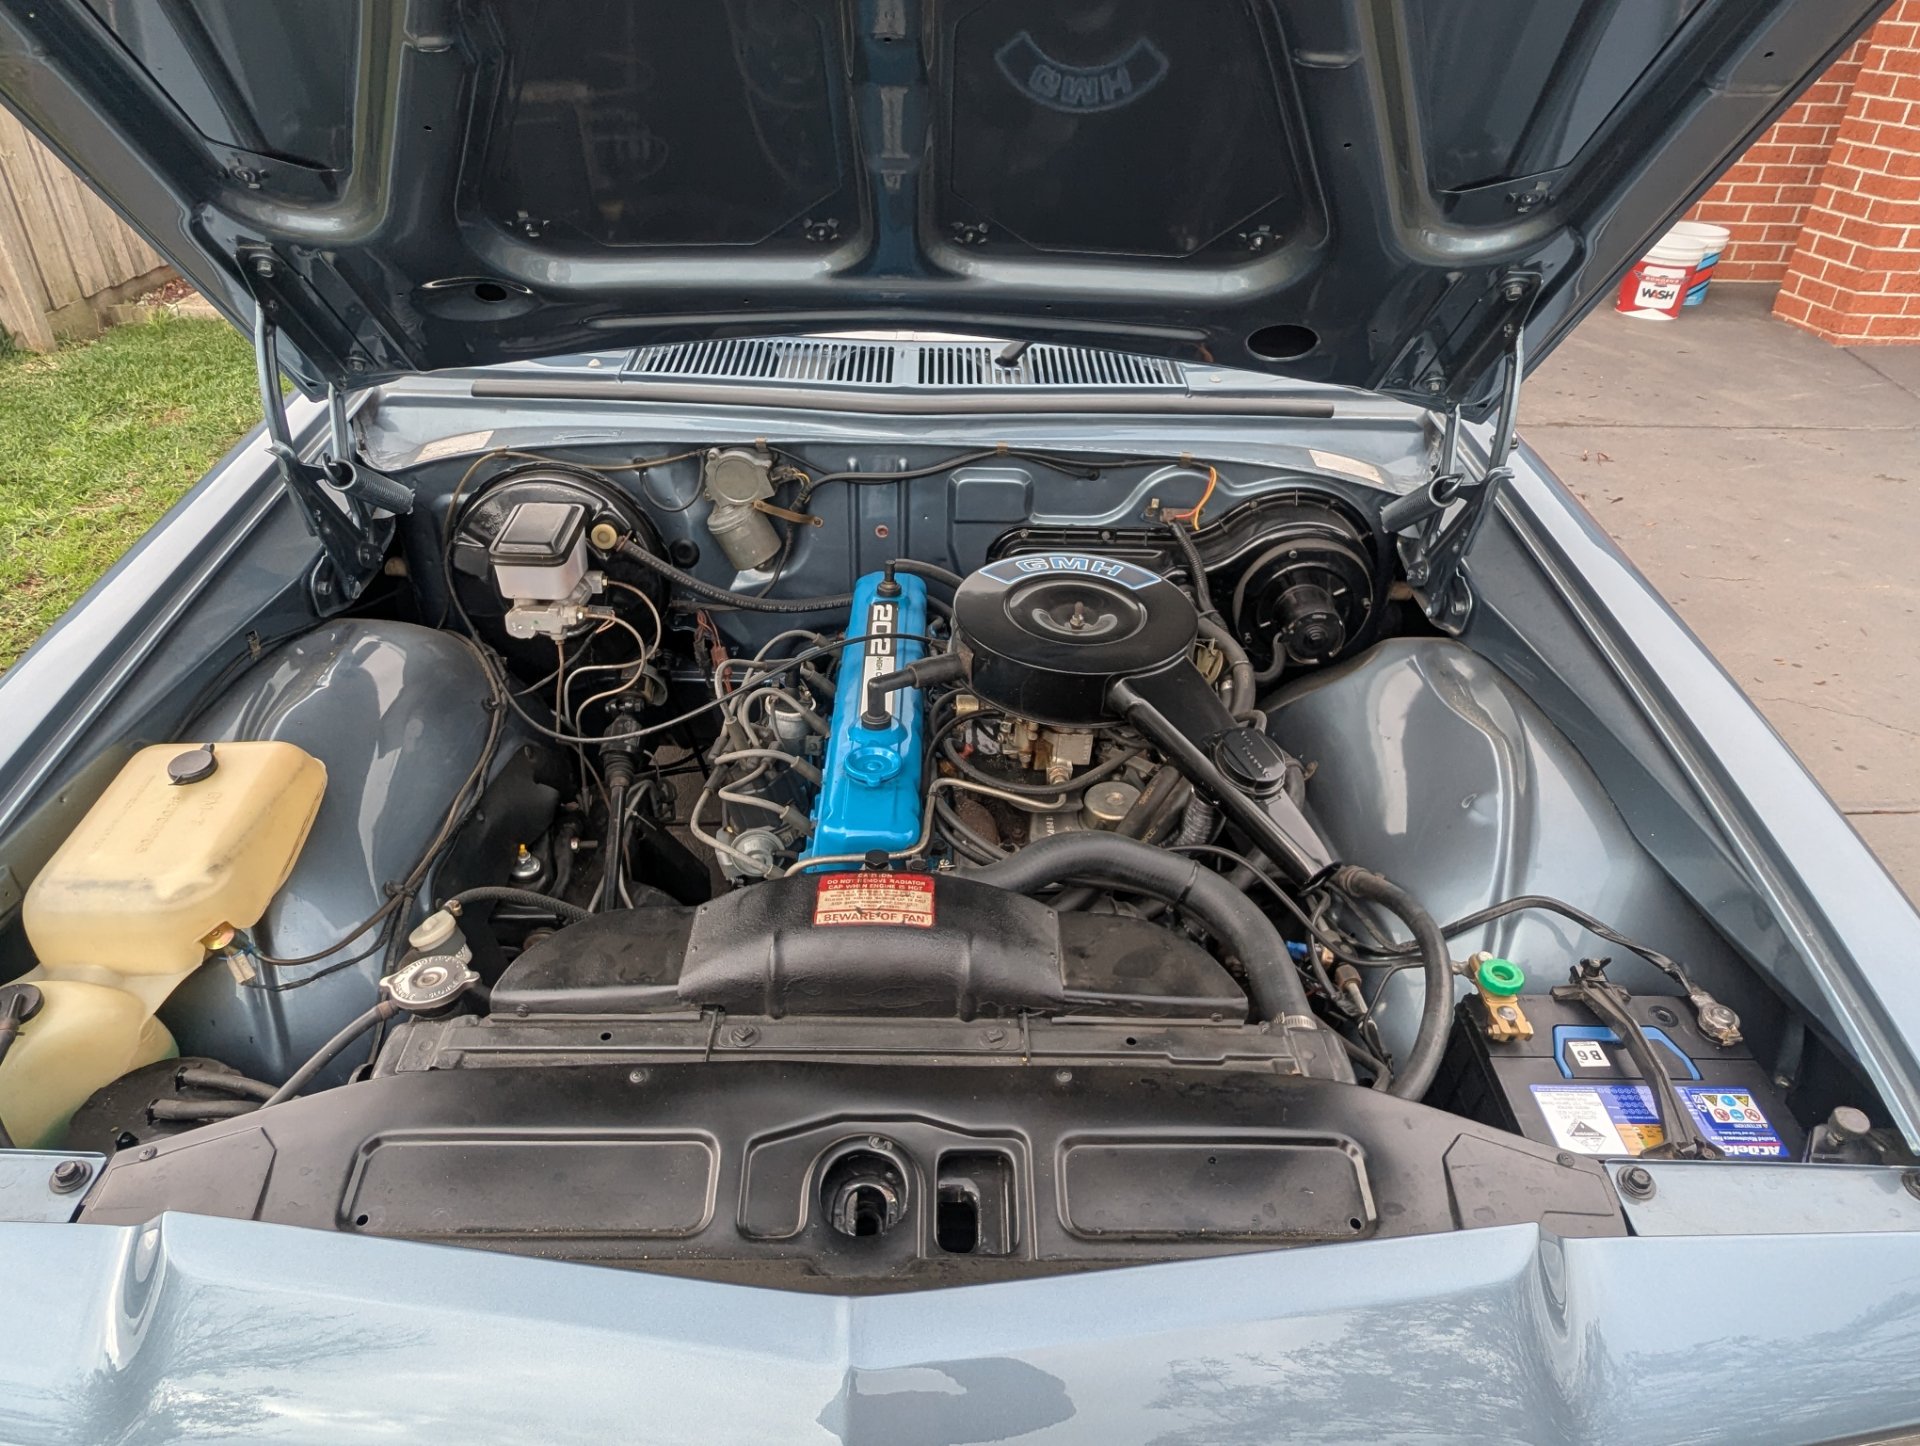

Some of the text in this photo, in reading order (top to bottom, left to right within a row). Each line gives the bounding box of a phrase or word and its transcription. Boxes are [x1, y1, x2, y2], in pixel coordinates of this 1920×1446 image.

[1641, 287, 1675, 300] WASH
[1016, 556, 1124, 577] GMH
[870, 604, 893, 655] 202
[889, 878, 926, 886] RADIATOR
[824, 913, 877, 921] BEWARE
[902, 914, 925, 922] FAN
[1719, 1145, 1781, 1157] ACDelc
